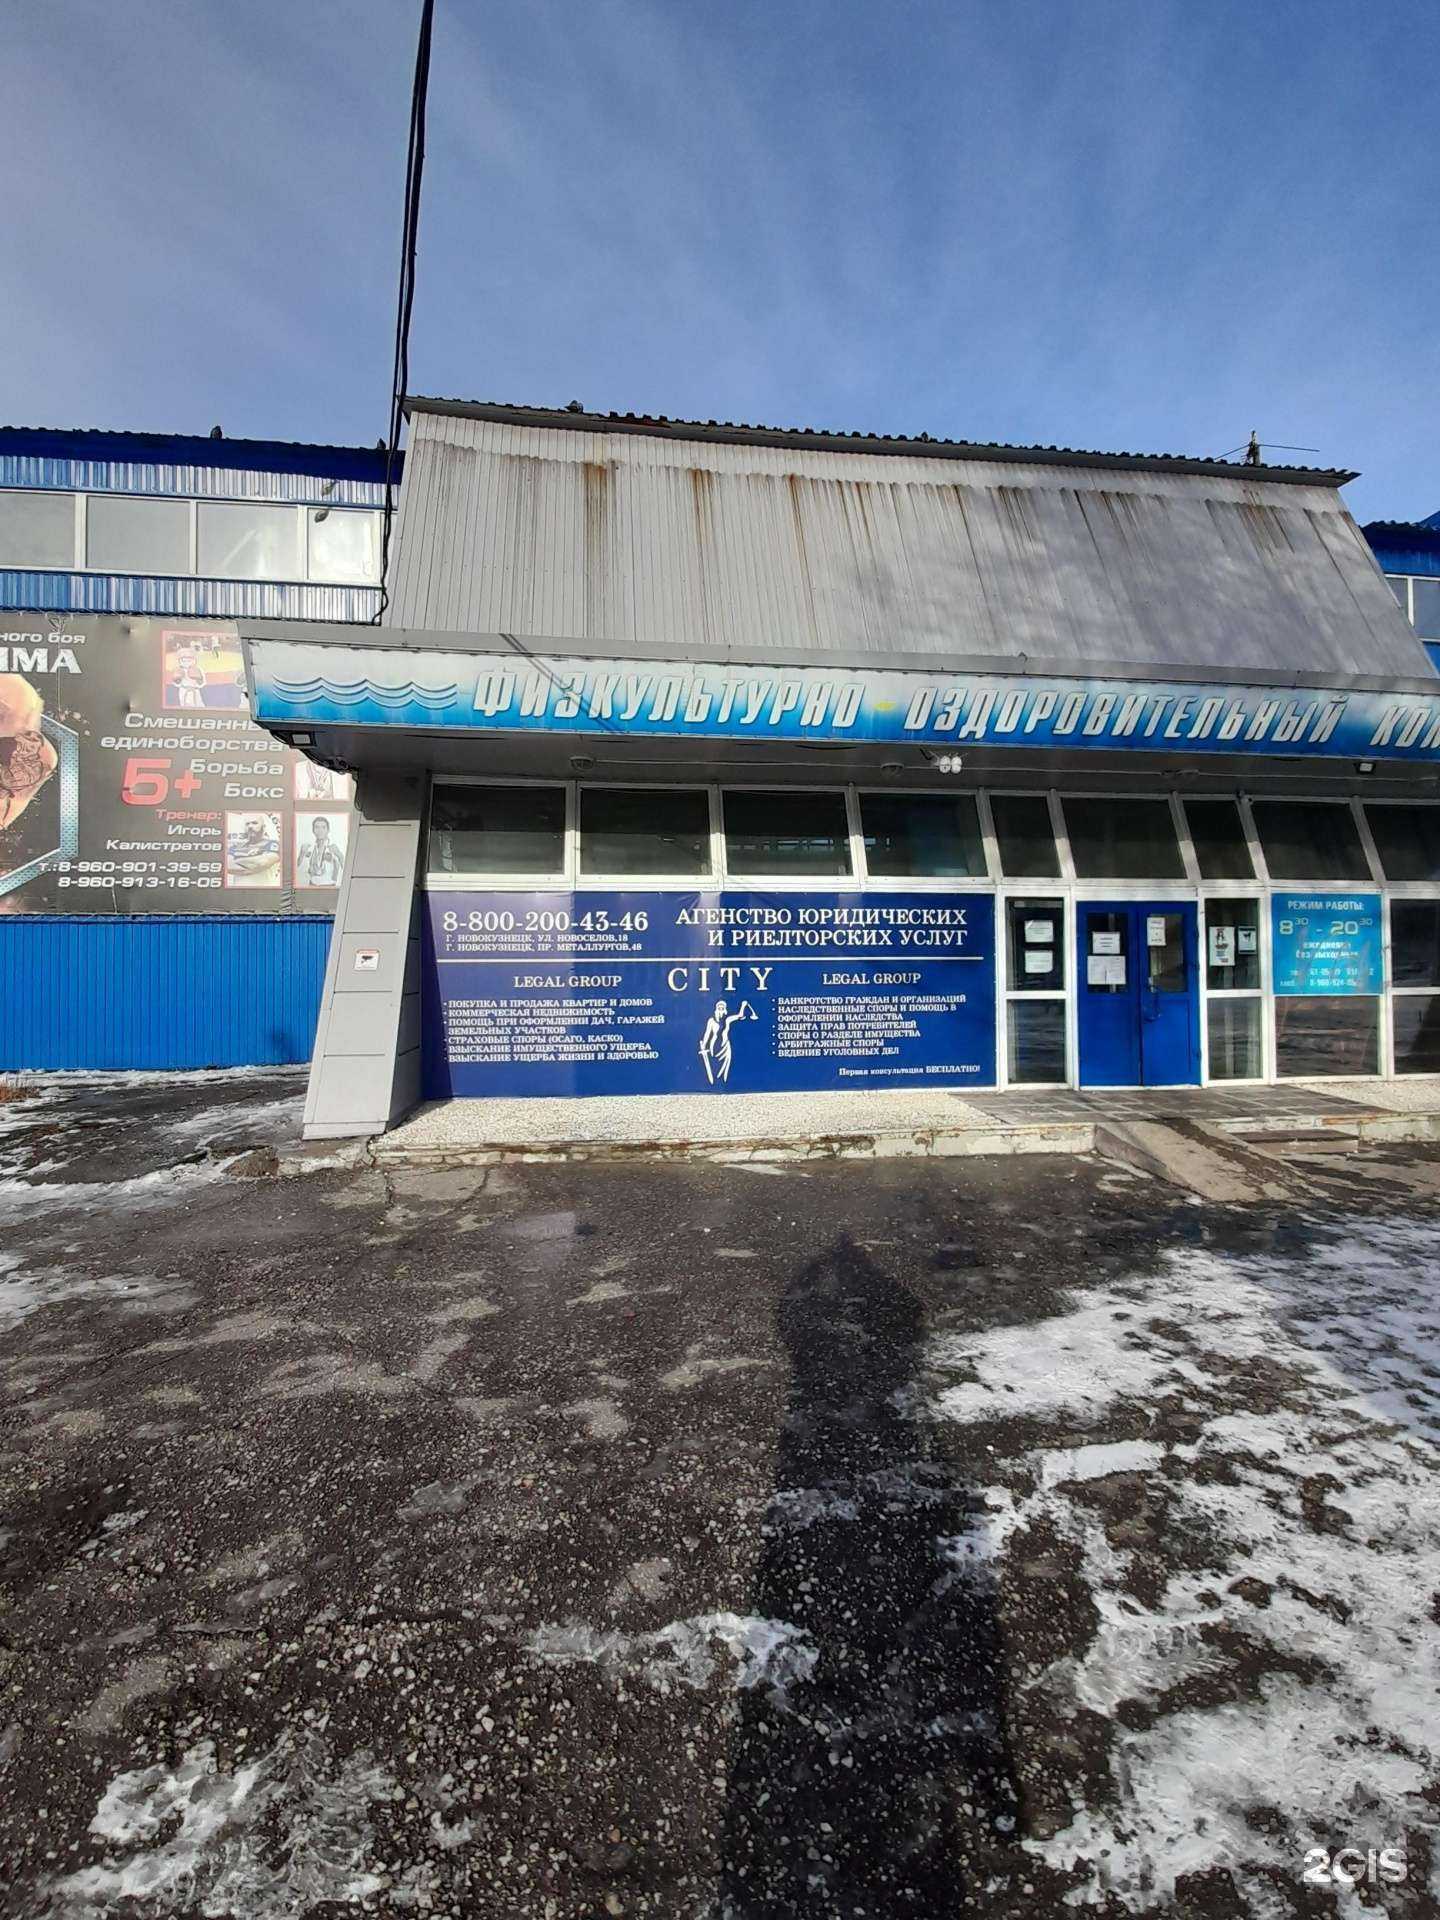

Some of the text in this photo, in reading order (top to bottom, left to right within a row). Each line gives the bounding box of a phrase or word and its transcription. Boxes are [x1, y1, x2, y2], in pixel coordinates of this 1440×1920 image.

[48, 632, 86, 644] боя
[0, 646, 82, 674] МА
[473, 671, 866, 728] ФИЗКУЛЬТУРНО
[903, 686, 1348, 743] ОЗДОРОВИТЕЛЬНЫЙ
[100, 735, 284, 754] единоборства
[189, 758, 284, 777] Борьба
[223, 782, 285, 798] Бокс
[167, 824, 222, 837] Игорь
[106, 839, 222, 853] Калистратов
[1287, 901, 1323, 910] РЕЖИМ
[443, 911, 648, 931] 8-800-200-43-46
[676, 908, 967, 927] АГЕНСТВО ЮРИДИЧЕСКИХ
[708, 929, 967, 946] И РИЕЛТОРСКИХ УСЛУГ
[514, 975, 622, 988] LEGAL GROUP
[668, 967, 773, 992] CITY
[822, 973, 921, 985] LEGAL GROUP
[448, 1000, 497, 1008] ПОКУПКА
[500, 1000, 508, 1008] И
[510, 999, 560, 1009] ПРОДАЖА
[562, 999, 607, 1007] КВАРТИР
[619, 998, 653, 1007] ДОМОВ
[778, 997, 843, 1005] БАНКРОТСТВО
[845, 996, 890, 1005] ГРАЖДАН
[900, 994, 966, 1004] ОРГАНИЗАЦИЙ
[448, 1008, 615, 1017] КОММЕРЧЕСКАЯ НЕДВИЖИМОСТЬ
[778, 1005, 865, 1014] НАСЛЕДСТВЕННЫЕ
[867, 1004, 898, 1013] СПОРЫ
[900, 1004, 907, 1012] И
[909, 1004, 949, 1013] ПОМОЩЬ
[448, 1018, 494, 1027] ПОМОЩЬ
[497, 1018, 517, 1026] ПРИ
[519, 1017, 588, 1026] ОФОРМЛЕНИИ
[617, 1015, 665, 1024] ГАРАЖЕЙ
[778, 1013, 903, 1022] ОФОРМЛЕНИИ НАСЛЕДСТВА
[448, 1026, 566, 1035] ЗЕМЕЛЬНЫХ УЧАСТКОВ
[778, 1020, 917, 1031] ЗАЩИТА ПРАВ ПОТРЕБИТЕЛЕЙ
[448, 1036, 509, 1044] СТРАХОВЫЕ
[511, 1036, 546, 1044] СПОРЫ
[588, 1034, 624, 1042] КАСКО)
[778, 1031, 810, 1040] СПОРЫ
[821, 1030, 862, 1039] РАЗДЕЛЕ
[864, 1029, 921, 1038] ИМУЩЕСТВА
[449, 1042, 651, 1053] ВЗЫСКАНИЕ ИМУЩЕСТВЕННОГО УЩЕРБА
[778, 1039, 884, 1048] АРБИТРАЖНЫЕ СПОРЫ
[449, 1051, 659, 1062] ВЗЫСКАНИЕ УЩЕРБА ЖИЗНИ И ЗДОРОВЬЮ
[778, 1047, 899, 1057] ВЕДЕНИЕ УГОЛОВНЫХ ДЕЛ
